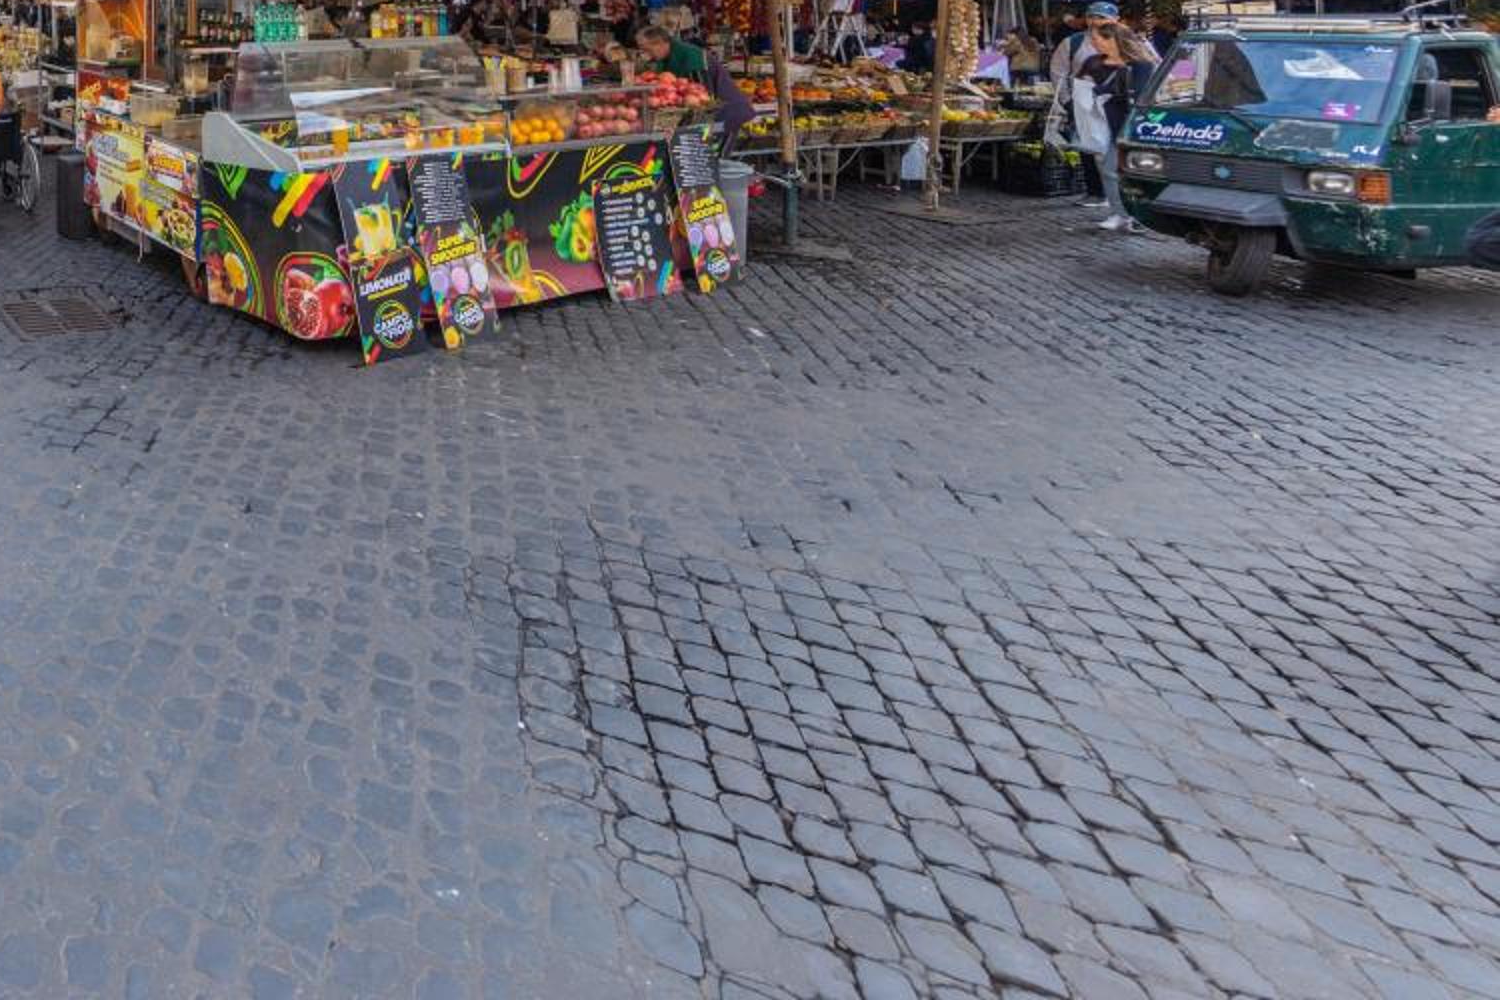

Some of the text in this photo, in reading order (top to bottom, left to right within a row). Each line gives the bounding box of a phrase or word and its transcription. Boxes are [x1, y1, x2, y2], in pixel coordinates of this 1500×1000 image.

[1136, 121, 1224, 141] Melinda
[437, 233, 463, 250] SUPER
[359, 266, 412, 296] LIMONATA
[373, 311, 409, 335] CAMPO
